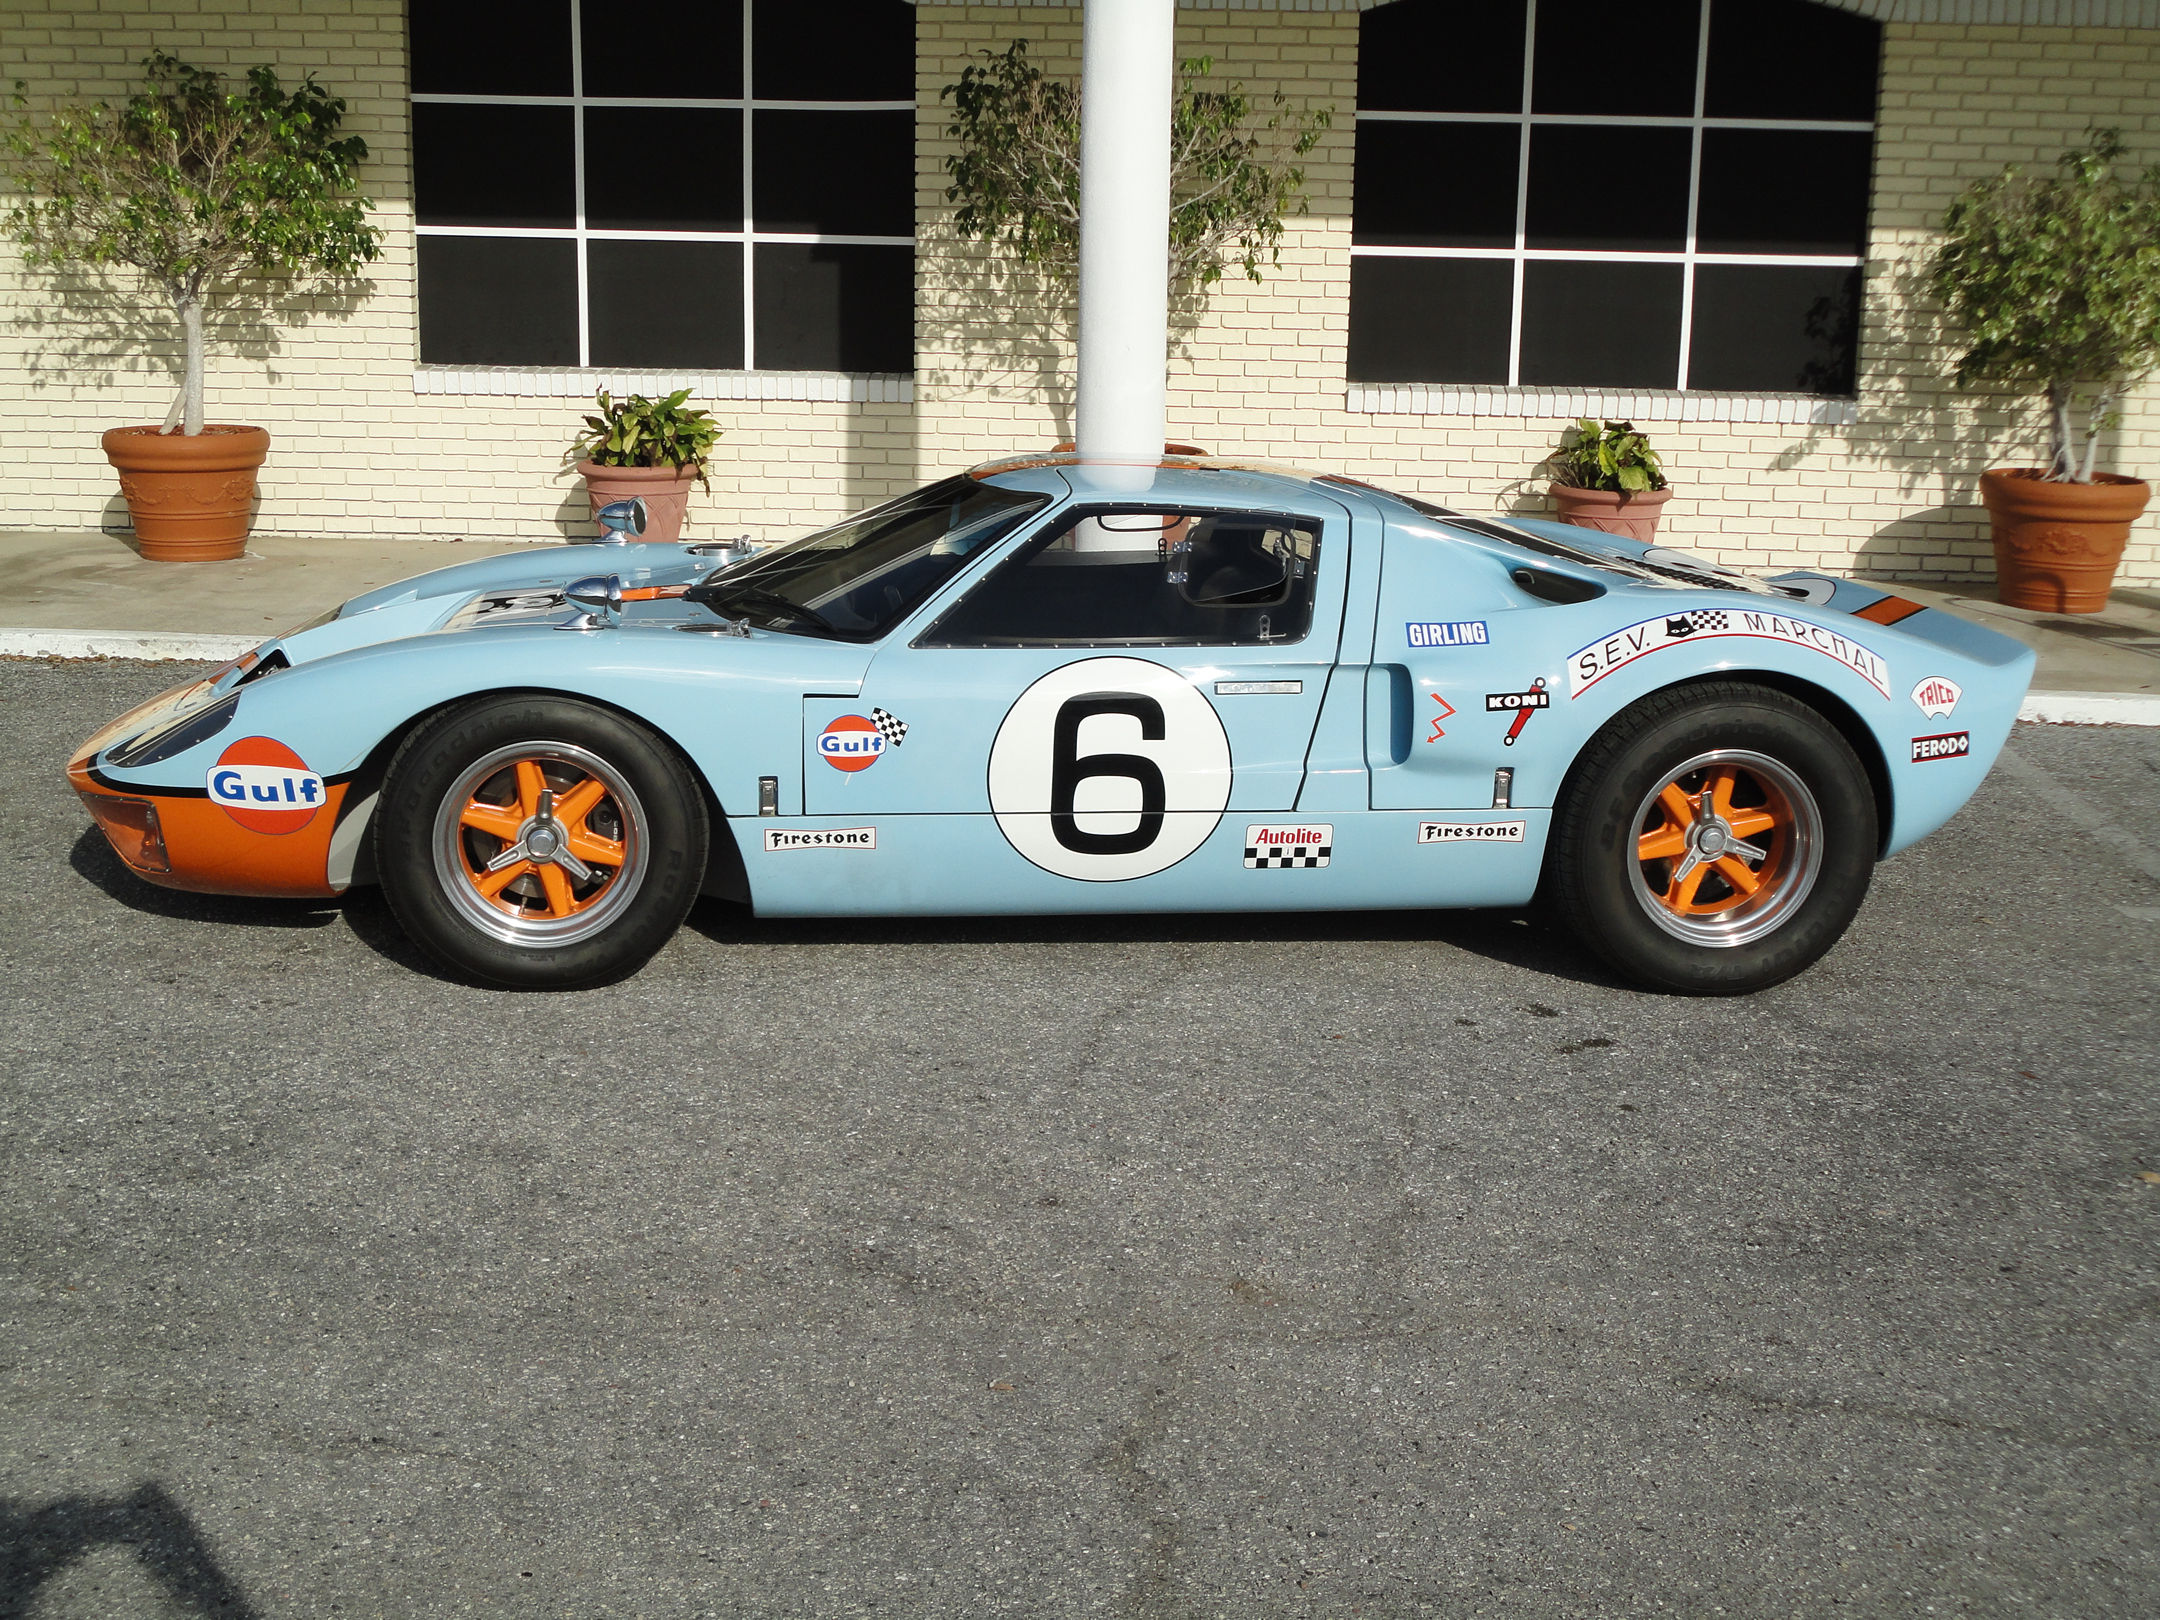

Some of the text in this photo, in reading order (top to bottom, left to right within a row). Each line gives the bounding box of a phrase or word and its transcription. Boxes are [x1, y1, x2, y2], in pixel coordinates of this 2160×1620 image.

[1408, 622, 1487, 646] GIRLING
[1580, 612, 1884, 686] S.E.V. MARCHAL
[1489, 693, 1547, 709] KONI
[1919, 680, 1955, 706] TRICO
[821, 735, 883, 752] Gulf
[1912, 735, 1969, 759] FERODO
[1050, 691, 1166, 855] 6
[213, 770, 318, 803] Gulf
[770, 832, 870, 848] Firestone
[1255, 828, 1322, 844] Autolite
[1425, 825, 1519, 840] Firestone
